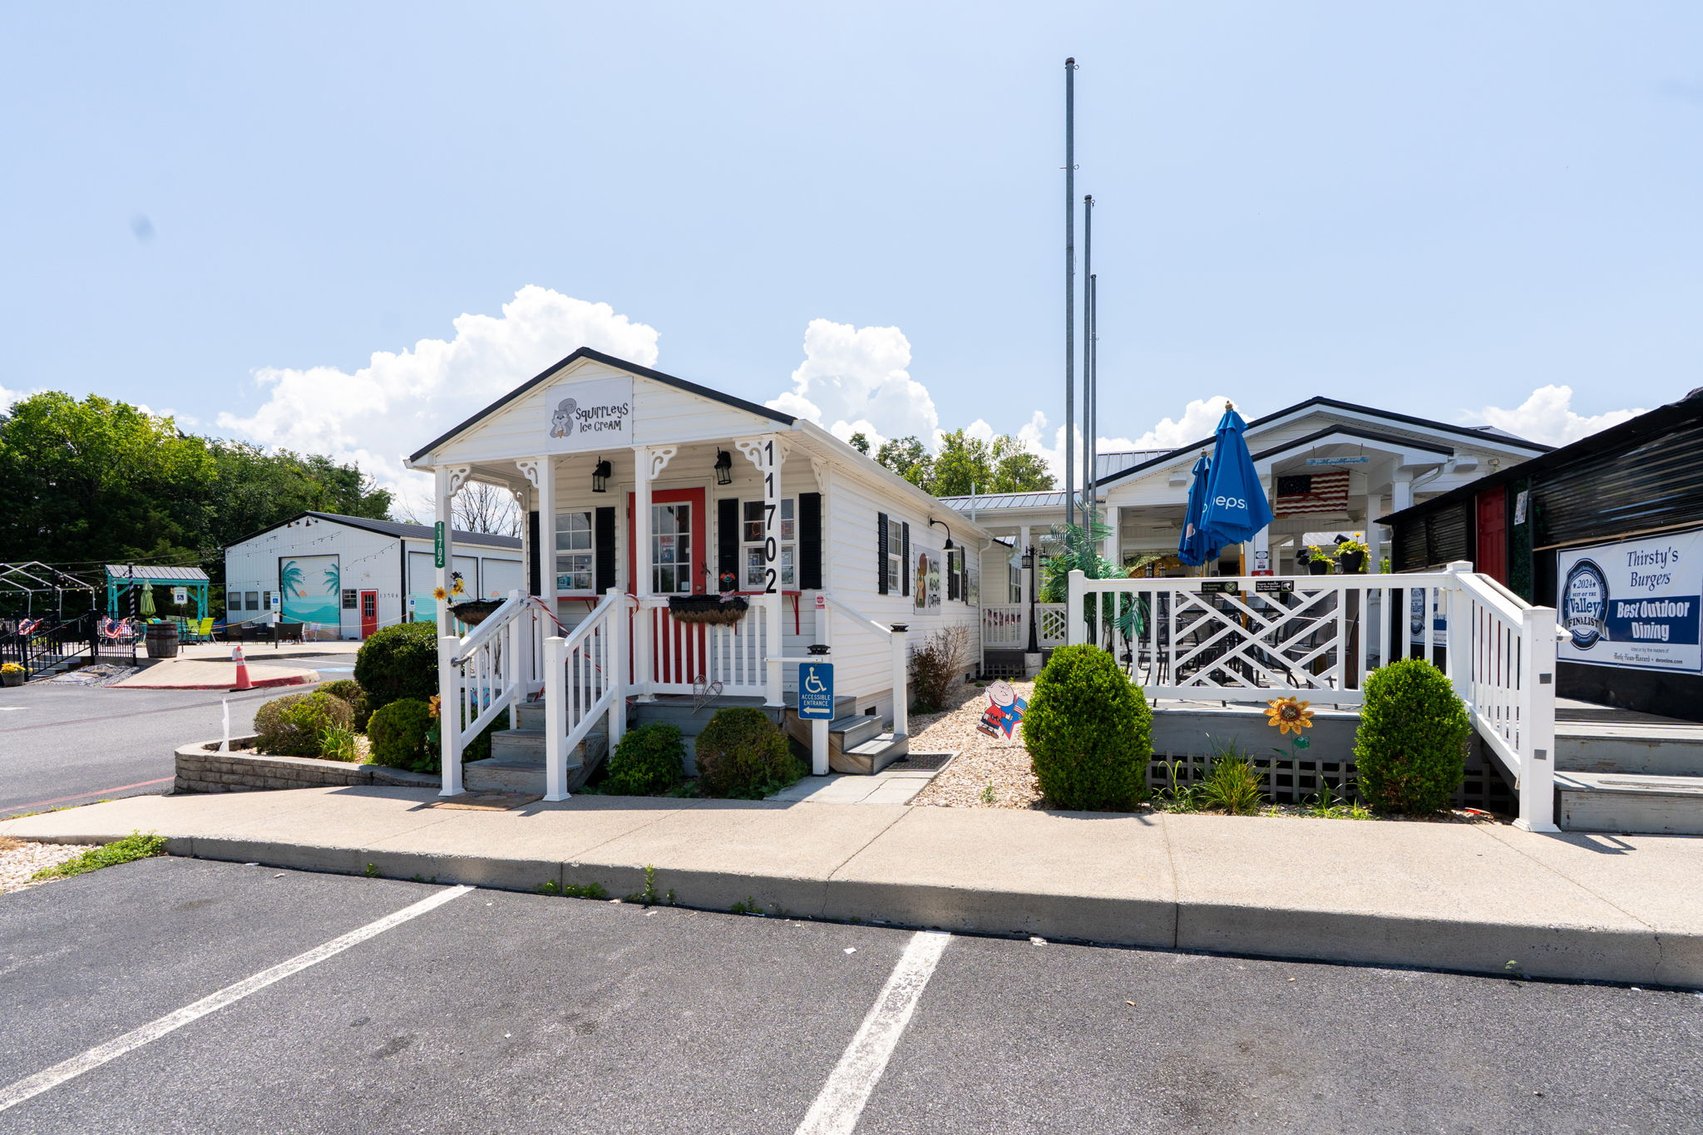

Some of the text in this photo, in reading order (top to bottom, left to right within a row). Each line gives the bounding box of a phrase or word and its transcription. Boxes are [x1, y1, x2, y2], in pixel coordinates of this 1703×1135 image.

[579, 422, 593, 433] Ice
[764, 440, 777, 594] 11702
[1626, 546, 1679, 570] Thirsty's
[1576, 578, 1593, 589] 2024
[1630, 571, 1672, 592] Burgers
[1569, 597, 1601, 617] Valley
[1616, 599, 1690, 619] Best Outdoor
[1568, 617, 1599, 627] FINALIST
[1631, 621, 1670, 642] Dining
